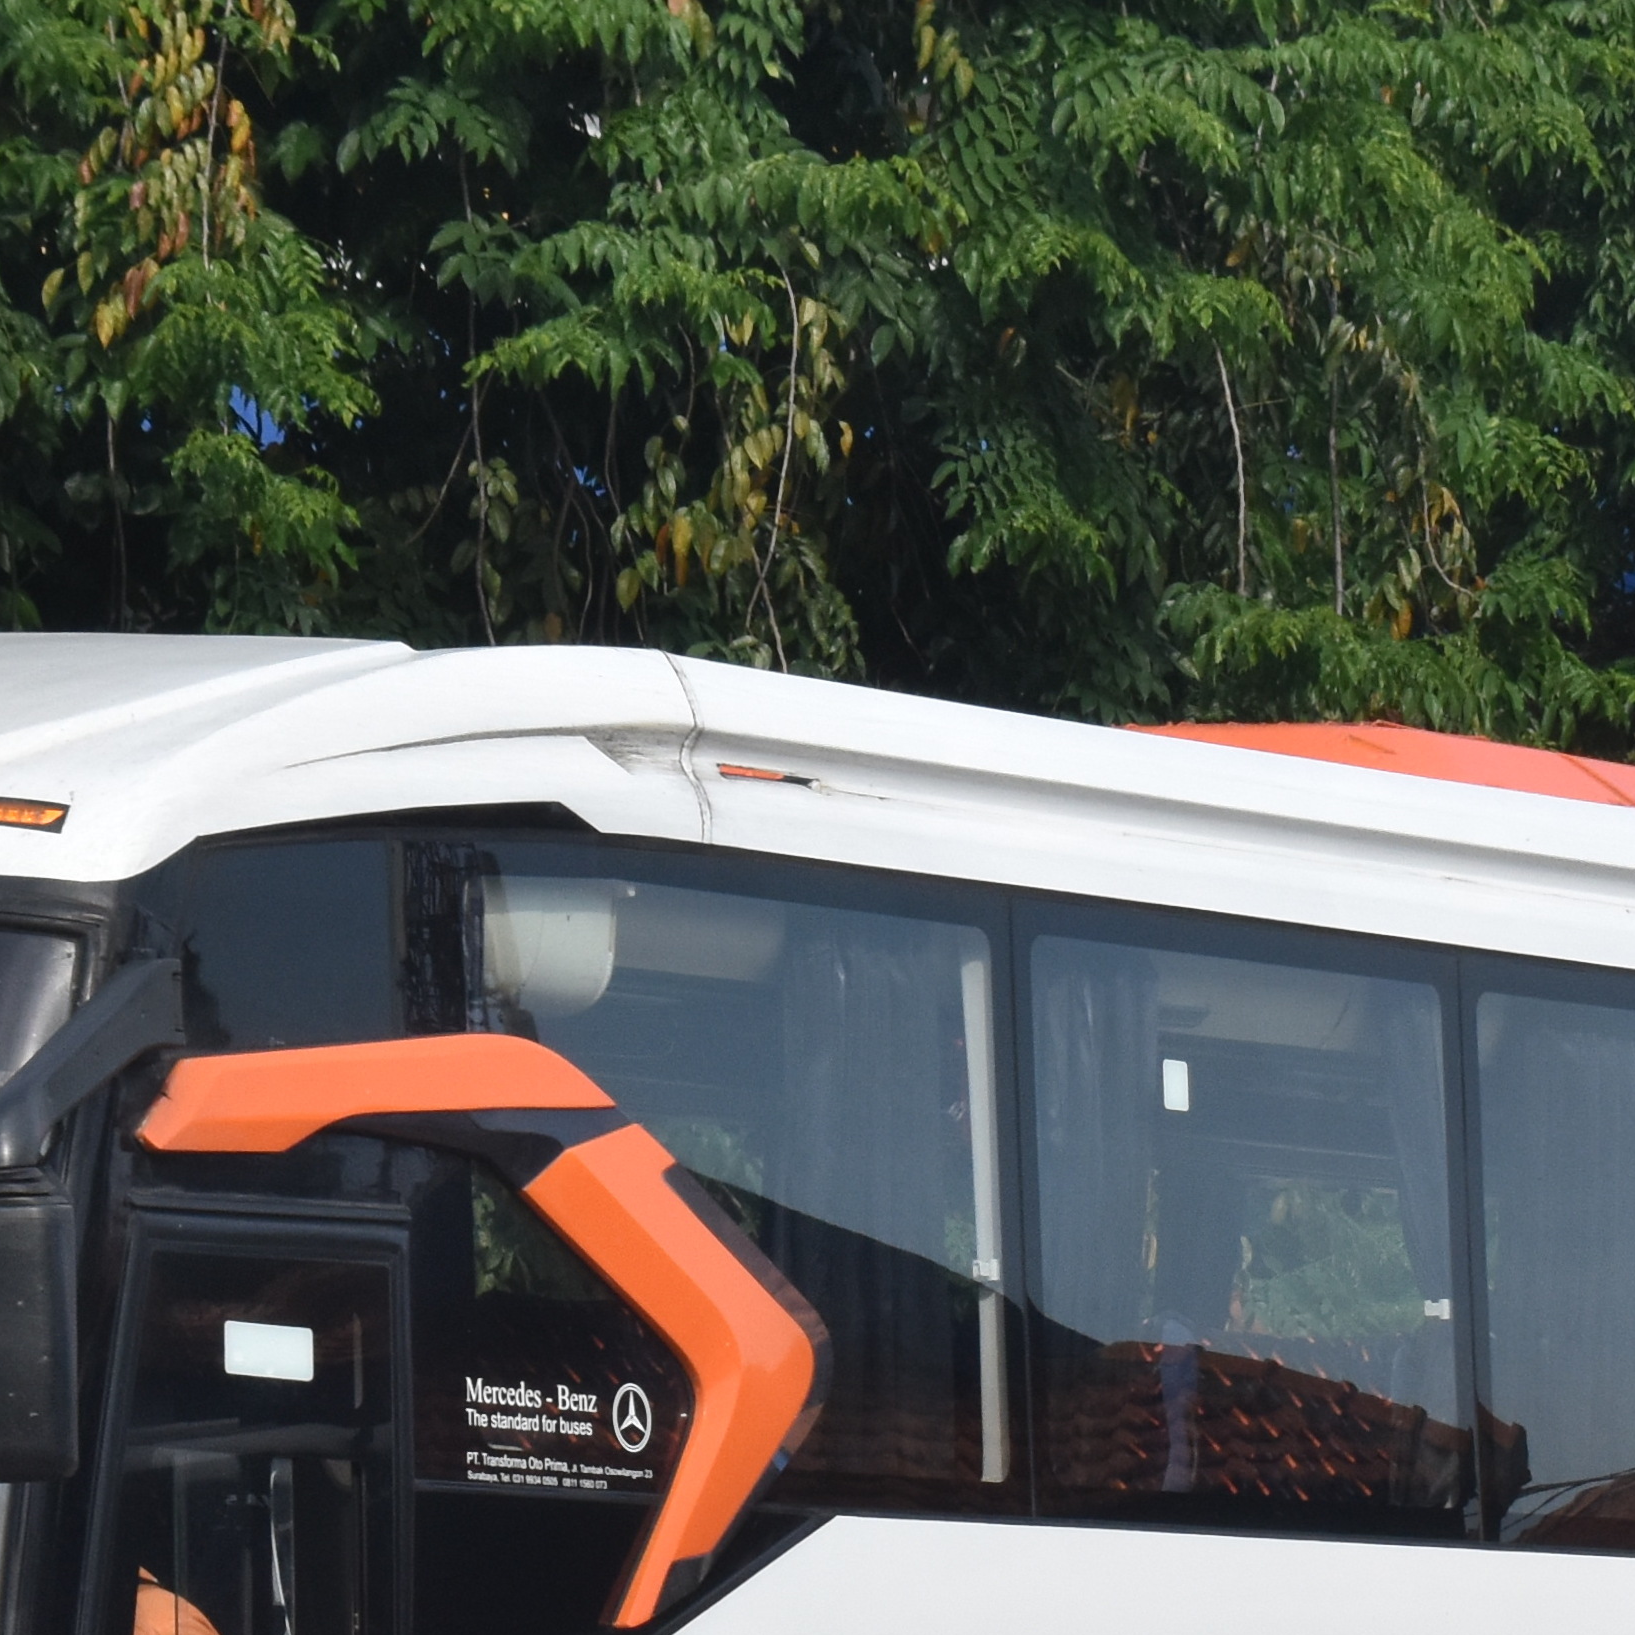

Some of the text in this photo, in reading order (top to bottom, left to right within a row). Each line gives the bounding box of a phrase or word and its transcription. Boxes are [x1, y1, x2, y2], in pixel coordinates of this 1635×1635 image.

[465, 1376, 542, 1409] Mercedes
[556, 1384, 598, 1413] Benz
[465, 1407, 593, 1437] The standard for buses
[466, 1451, 480, 1465] PT.
